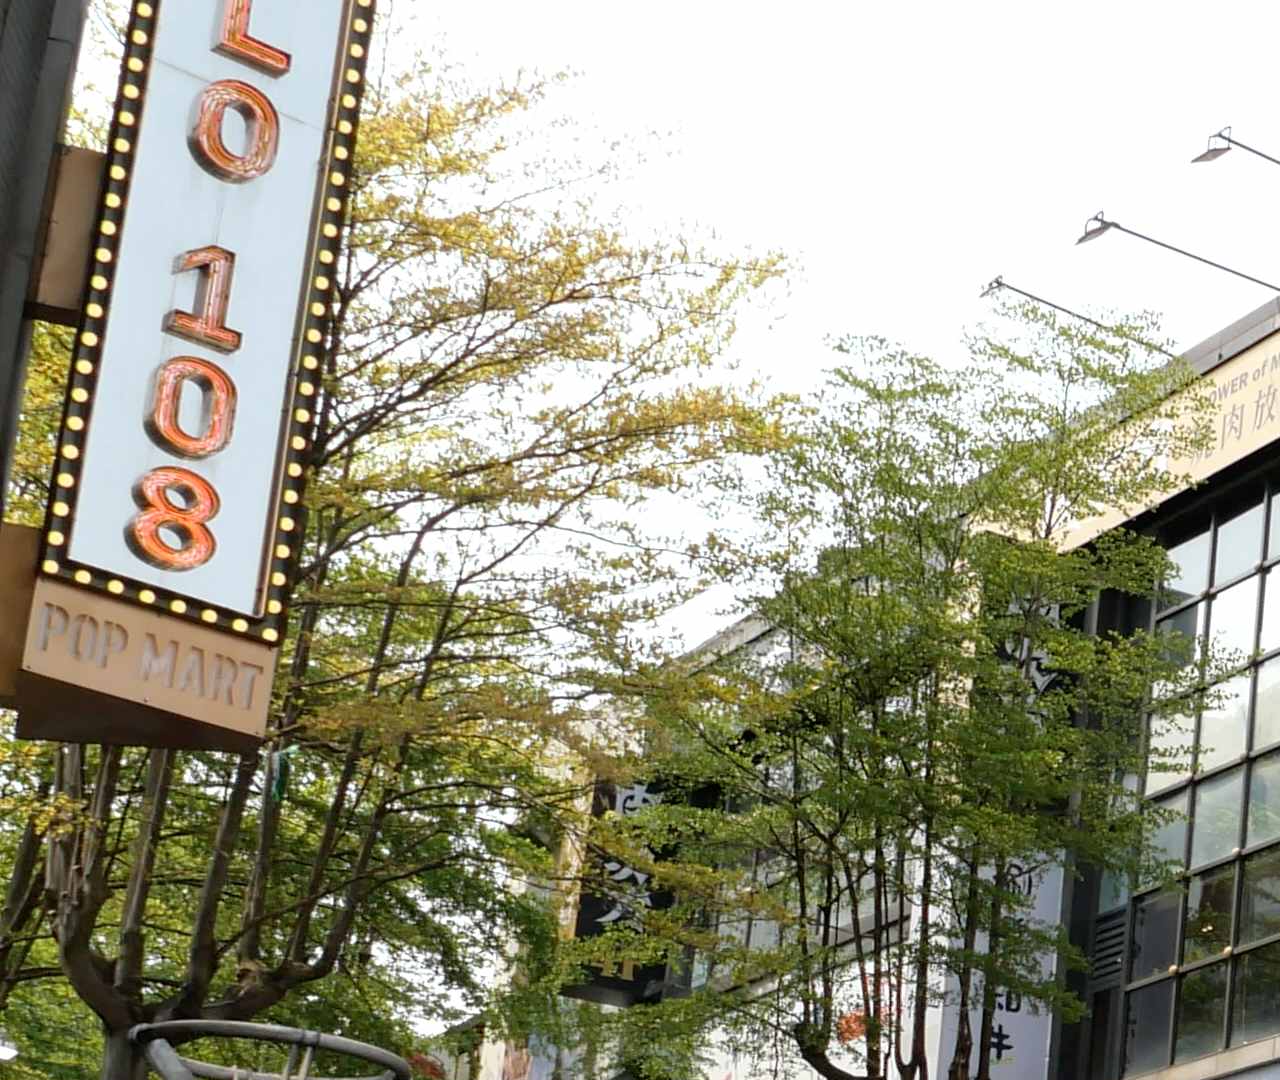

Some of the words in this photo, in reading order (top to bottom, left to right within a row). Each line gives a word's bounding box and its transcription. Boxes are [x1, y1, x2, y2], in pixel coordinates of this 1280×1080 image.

[123, 243, 243, 573] 108
[1252, 361, 1266, 383] of
[38, 602, 129, 669] POP
[136, 632, 265, 711] MART
